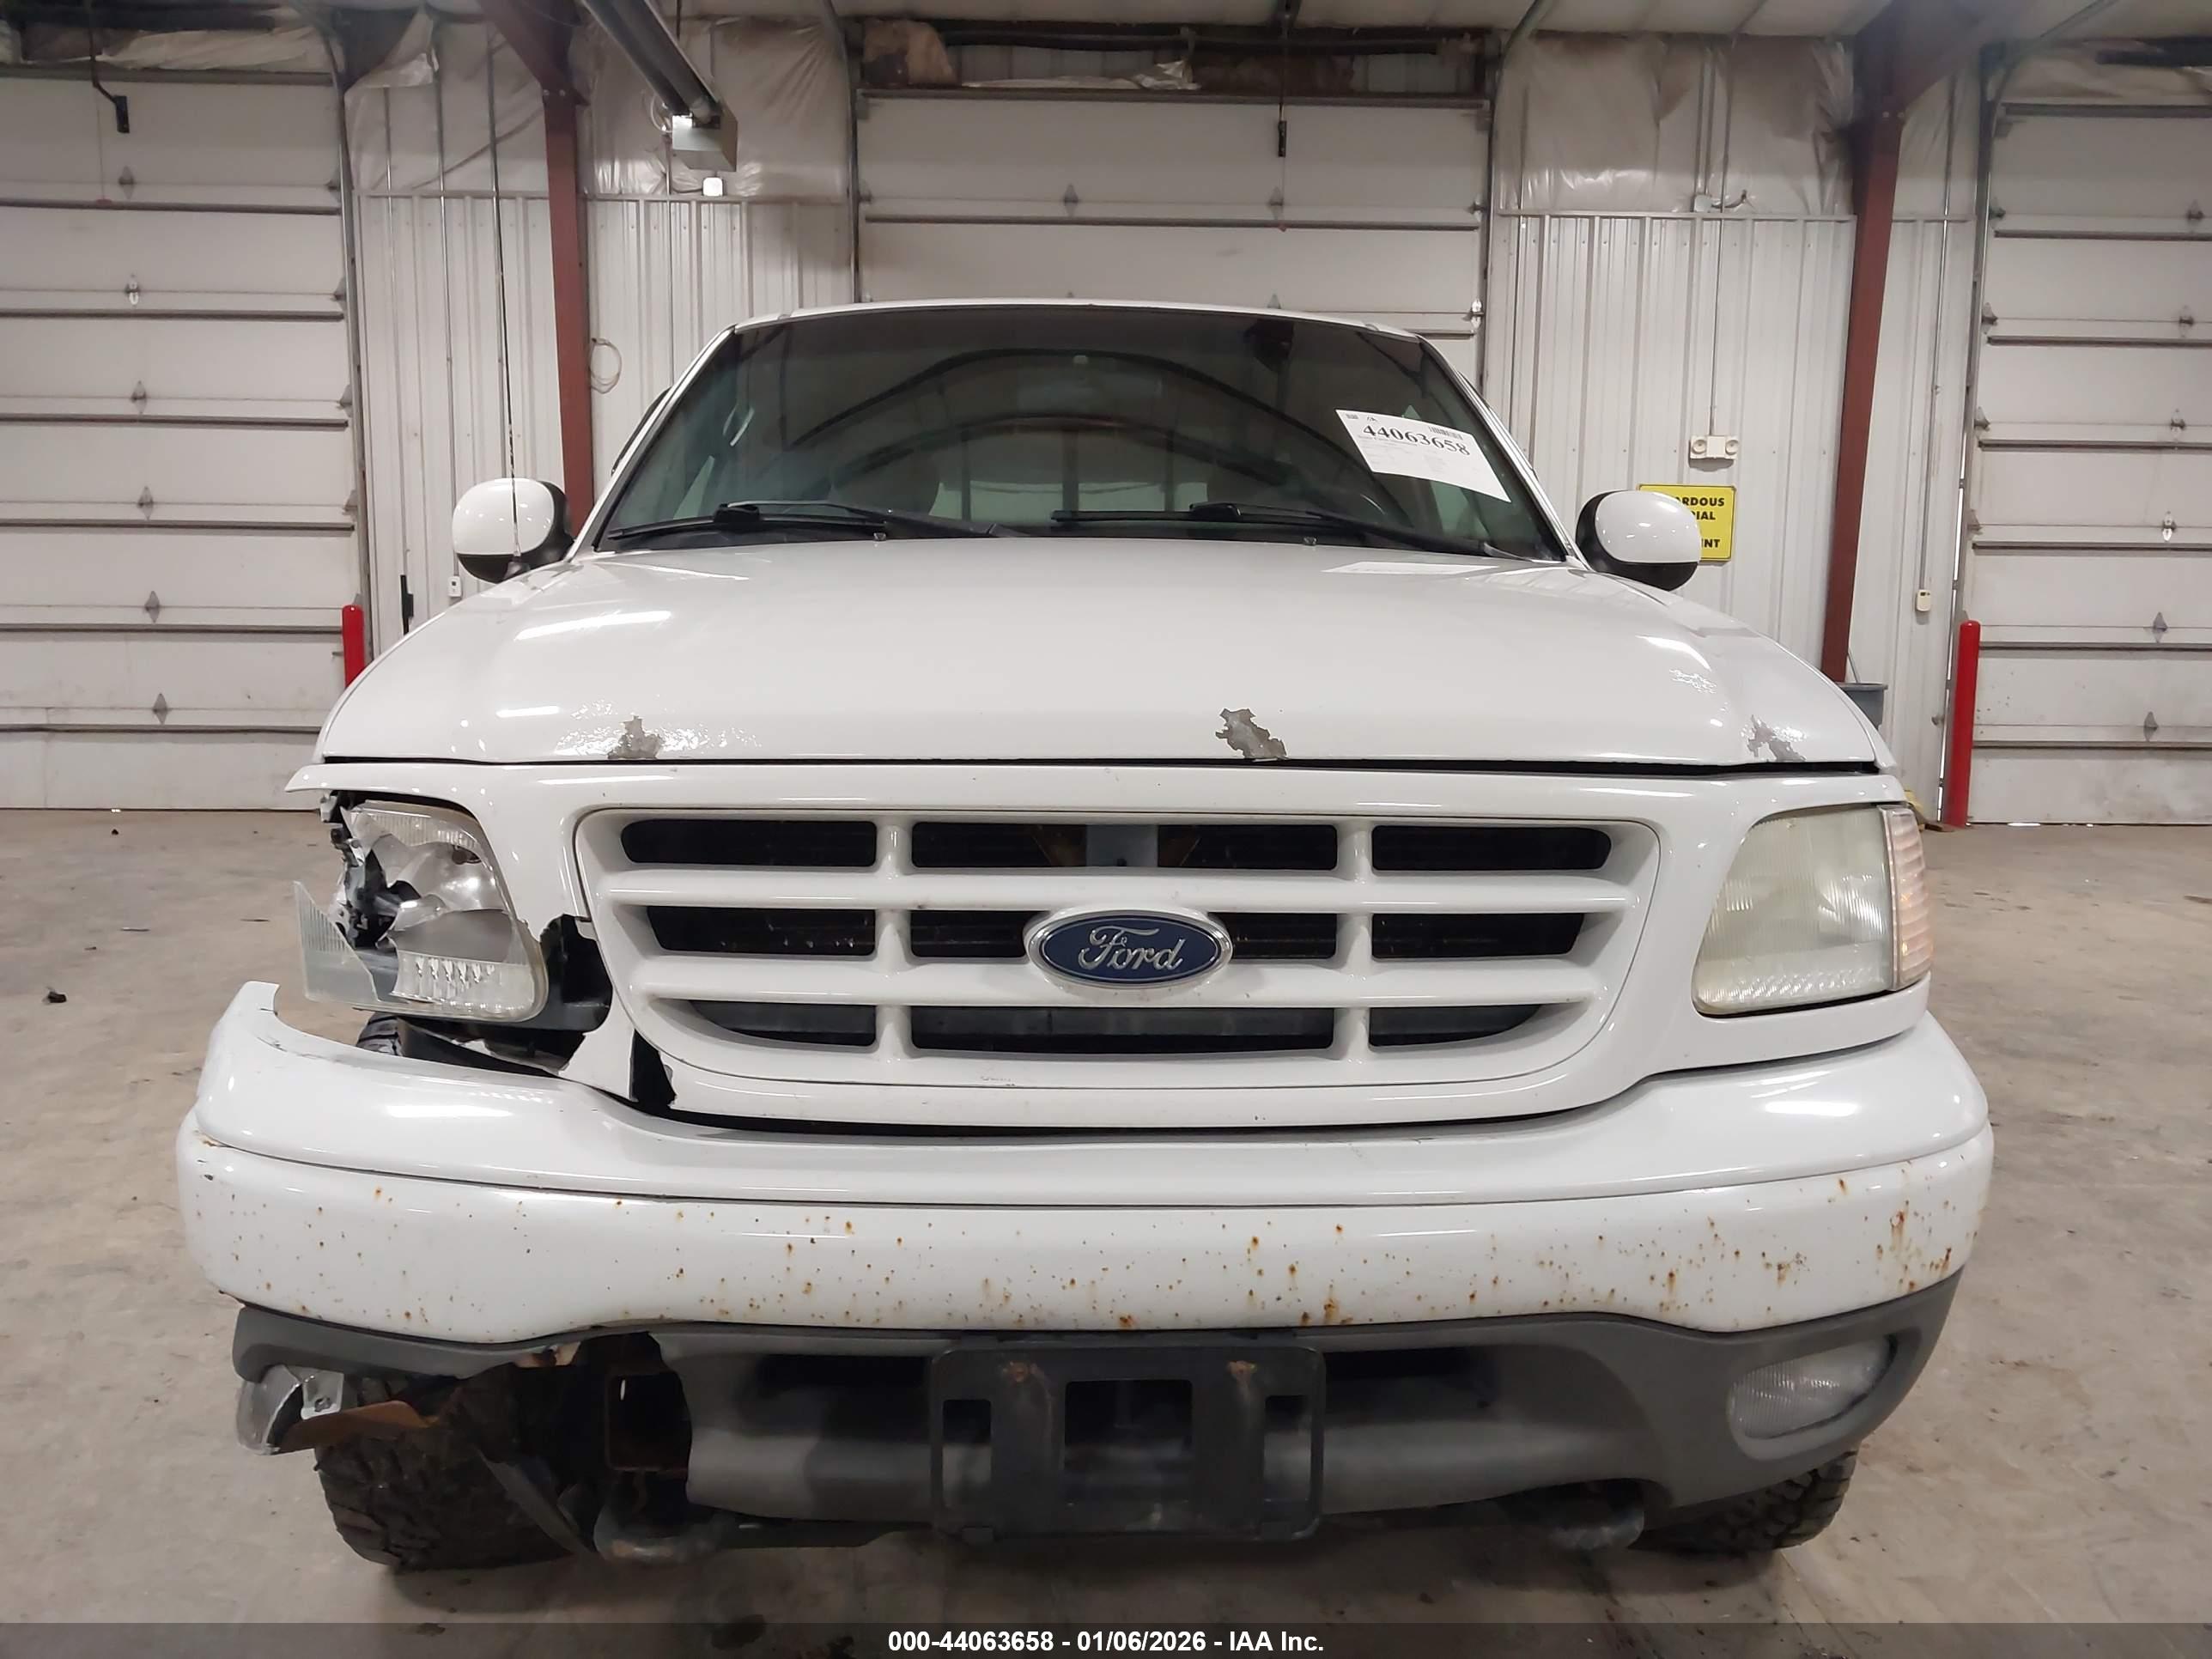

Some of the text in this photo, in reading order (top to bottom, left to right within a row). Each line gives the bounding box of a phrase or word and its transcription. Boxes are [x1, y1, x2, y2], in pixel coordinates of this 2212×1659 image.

[1363, 425, 1471, 456] 44063658
[1691, 510, 1717, 520] IAL
[1701, 538, 1721, 548] NT
[1079, 926, 1186, 969] Ford
